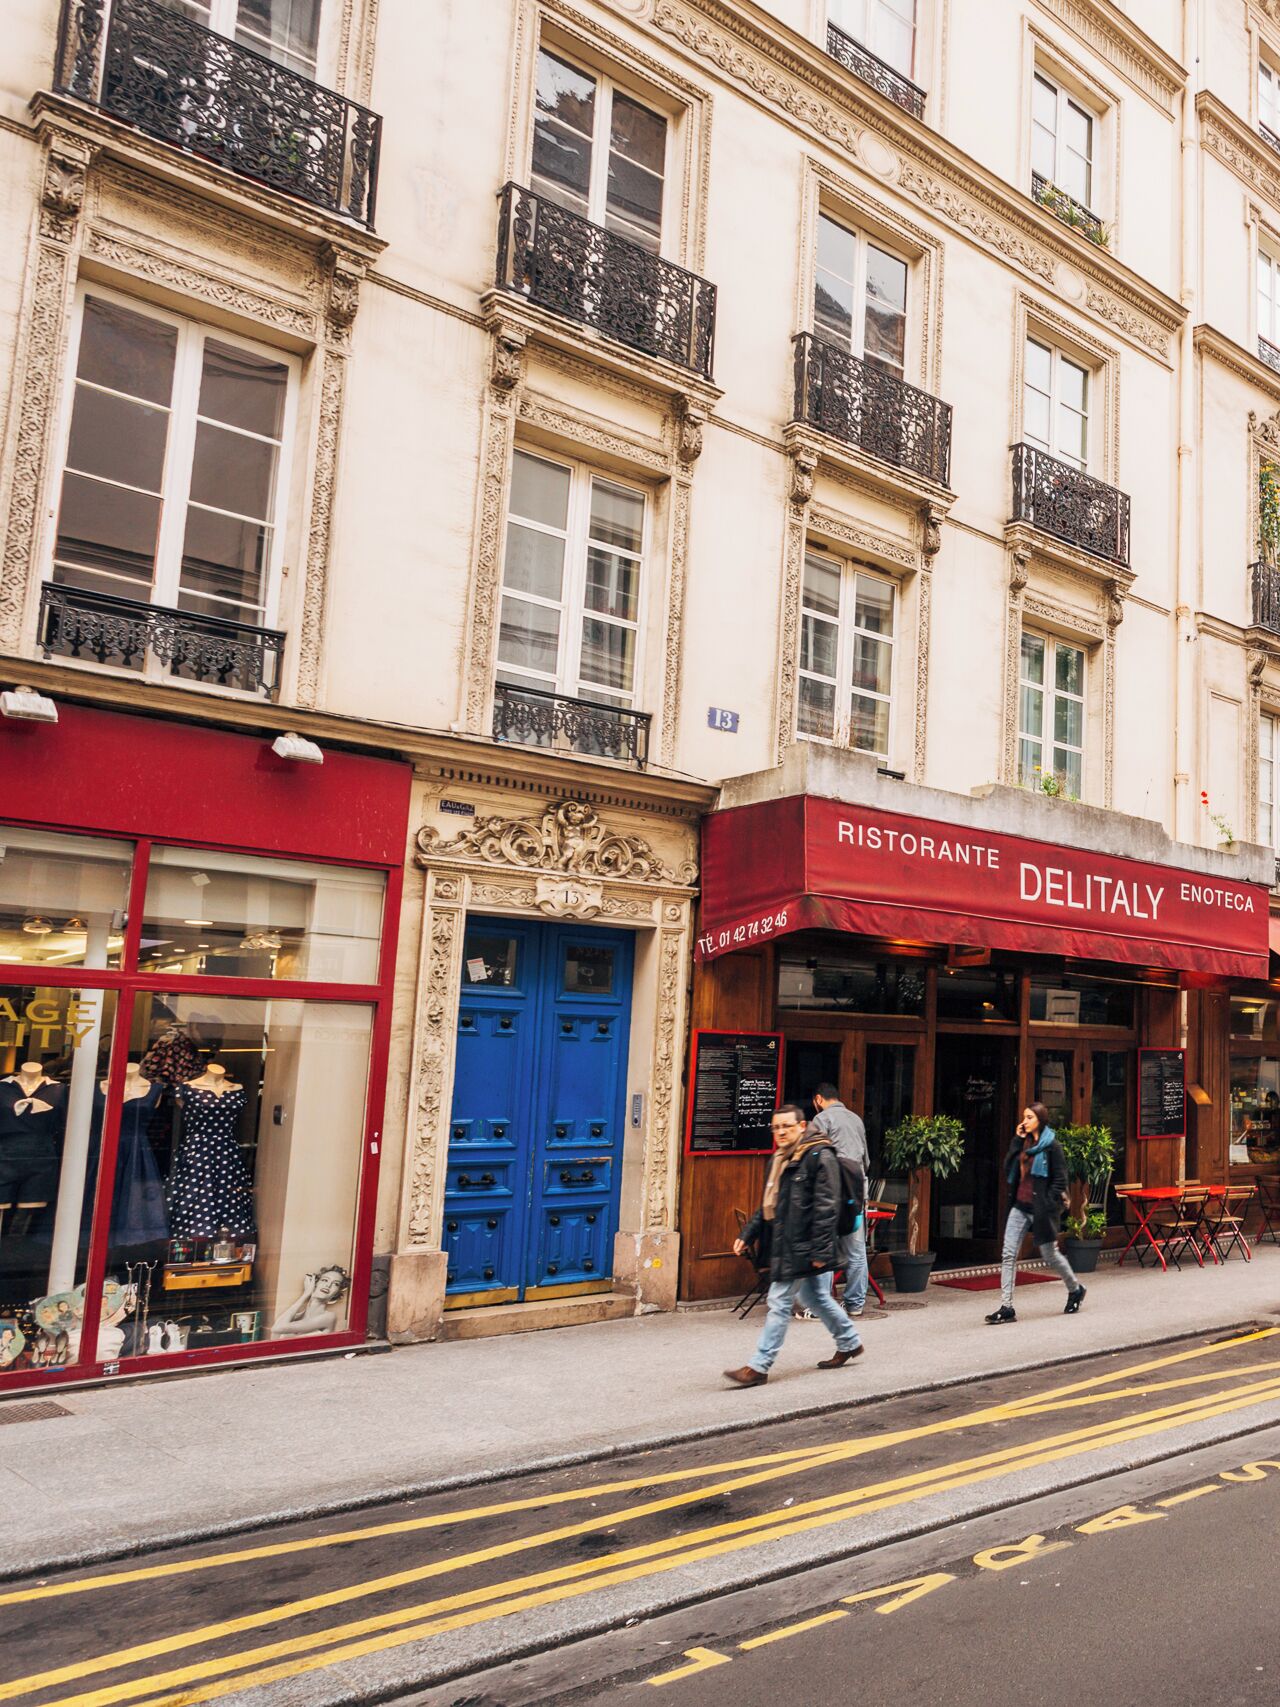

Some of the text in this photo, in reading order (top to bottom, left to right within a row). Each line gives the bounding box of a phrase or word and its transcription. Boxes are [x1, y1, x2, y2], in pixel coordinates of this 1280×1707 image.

[715, 709, 733, 729] 13
[837, 820, 1255, 920] RISTORANTE DELITALY ENOTECA
[564, 890, 579, 905] 13
[719, 930, 731, 948] 01
[733, 925, 746, 943] 42
[747, 921, 759, 938] 74
[760, 916, 773, 935] 32
[774, 910, 787, 928] 46
[0, 997, 97, 1023] AGE
